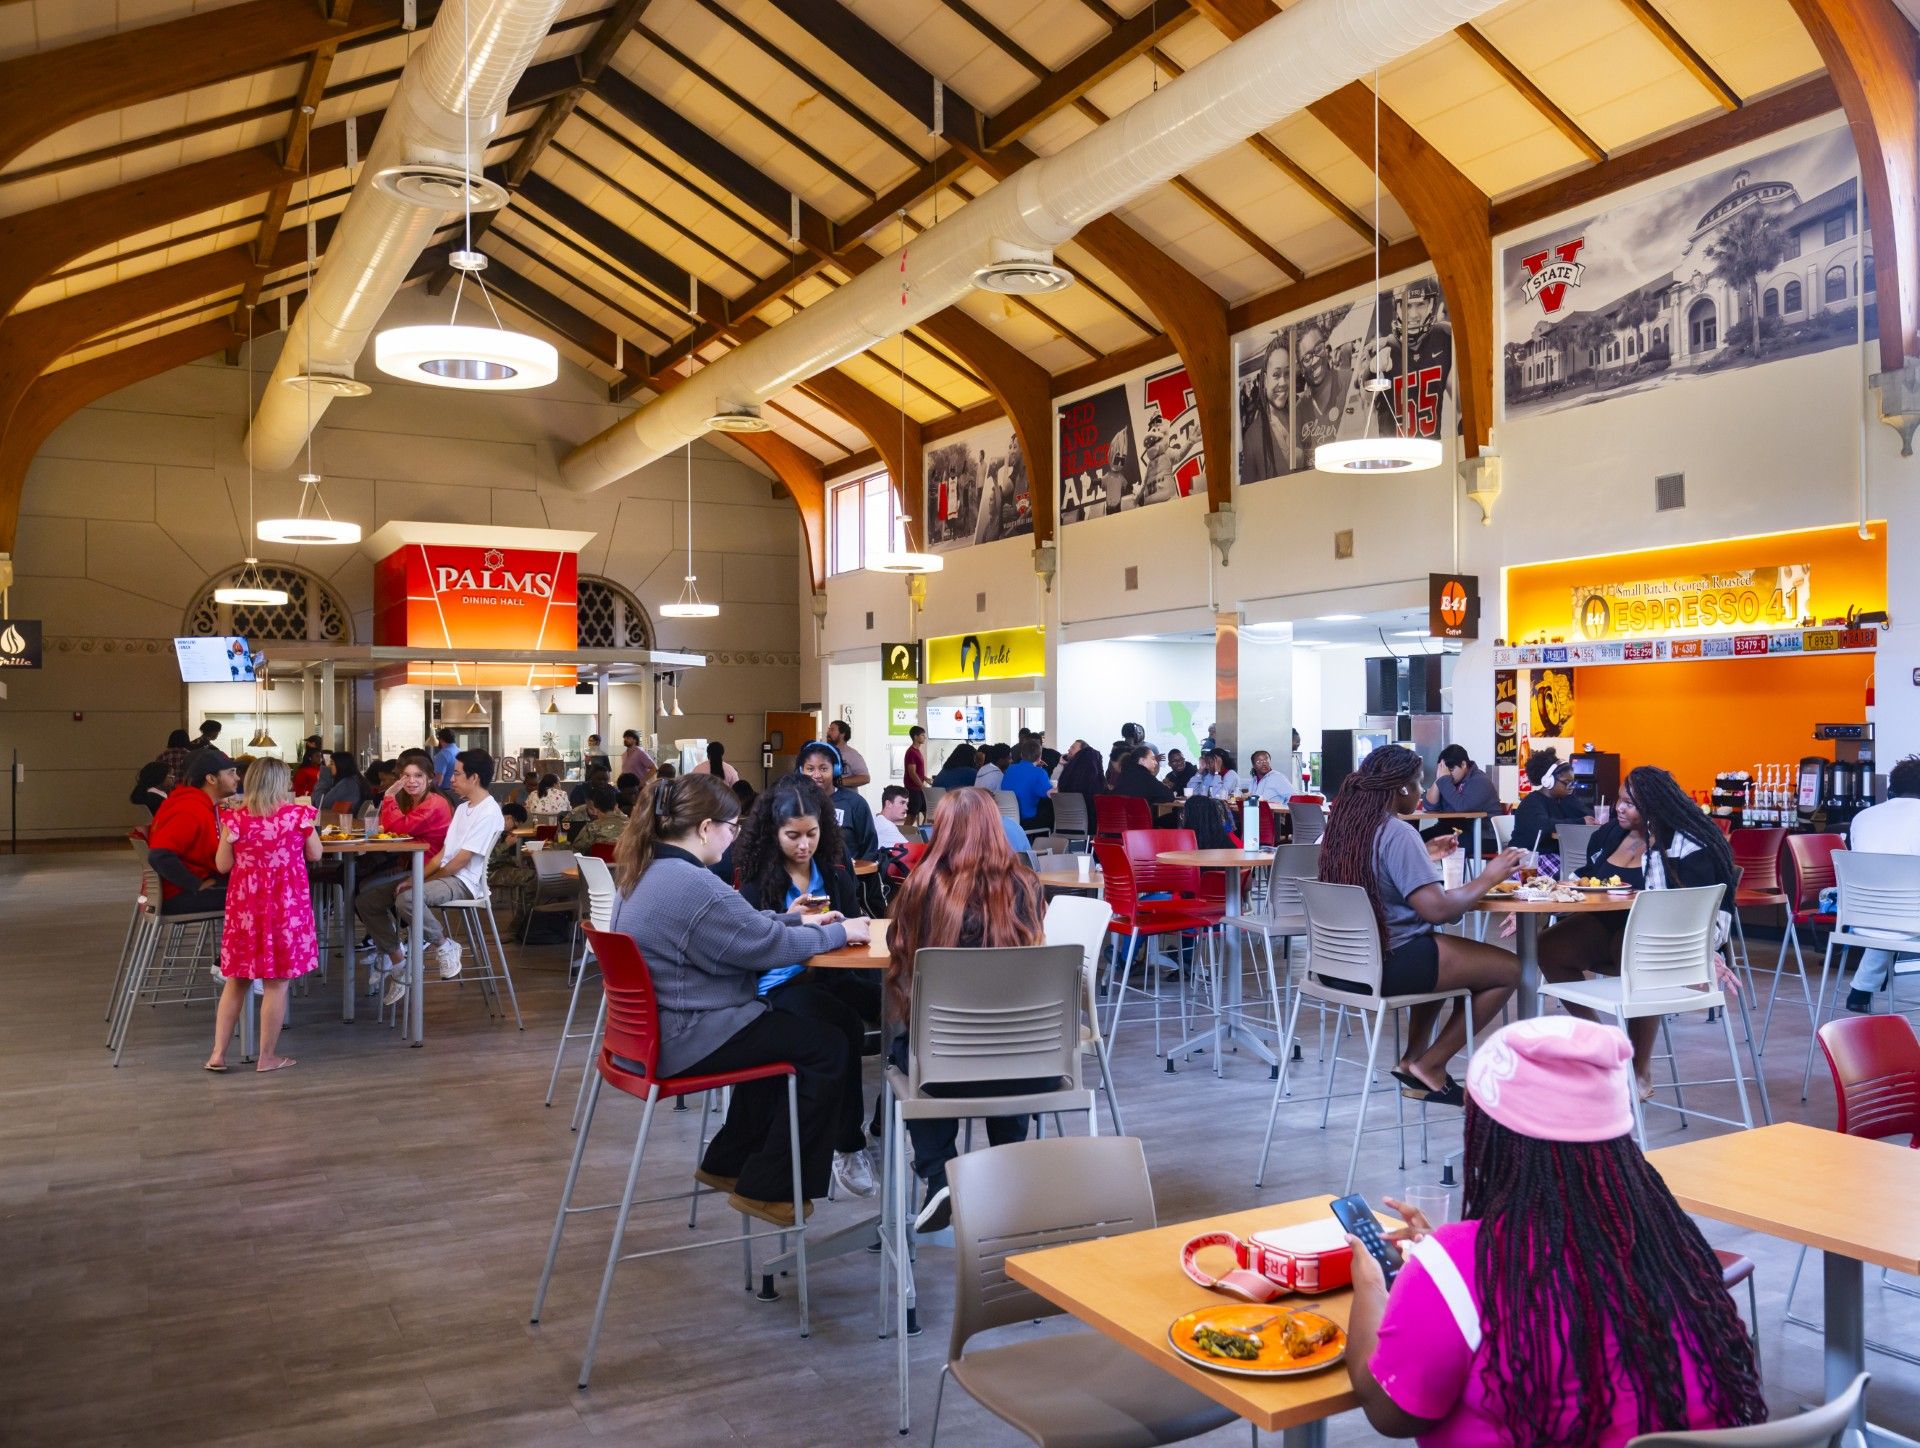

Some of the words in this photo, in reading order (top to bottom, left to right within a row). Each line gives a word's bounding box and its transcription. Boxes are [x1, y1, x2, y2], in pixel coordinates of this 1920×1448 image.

[1533, 266, 1573, 290] STATE
[1393, 365, 1442, 438] 55
[1062, 424, 1098, 451] AND
[1301, 419, 1337, 442] Blazer
[436, 566, 552, 598] PALMS
[1616, 583, 1641, 597] Small
[1643, 581, 1671, 594] Batch.
[1674, 576, 1710, 594] Georgia
[1712, 573, 1755, 588] Roasted.
[462, 596, 497, 605] DINING
[500, 598, 525, 606] HALL
[1441, 595, 1467, 612] E41
[1613, 590, 1760, 633] ESPRESSO
[1766, 586, 1798, 622] 41
[1496, 679, 1516, 701] XL
[1497, 738, 1517, 755] OIL
